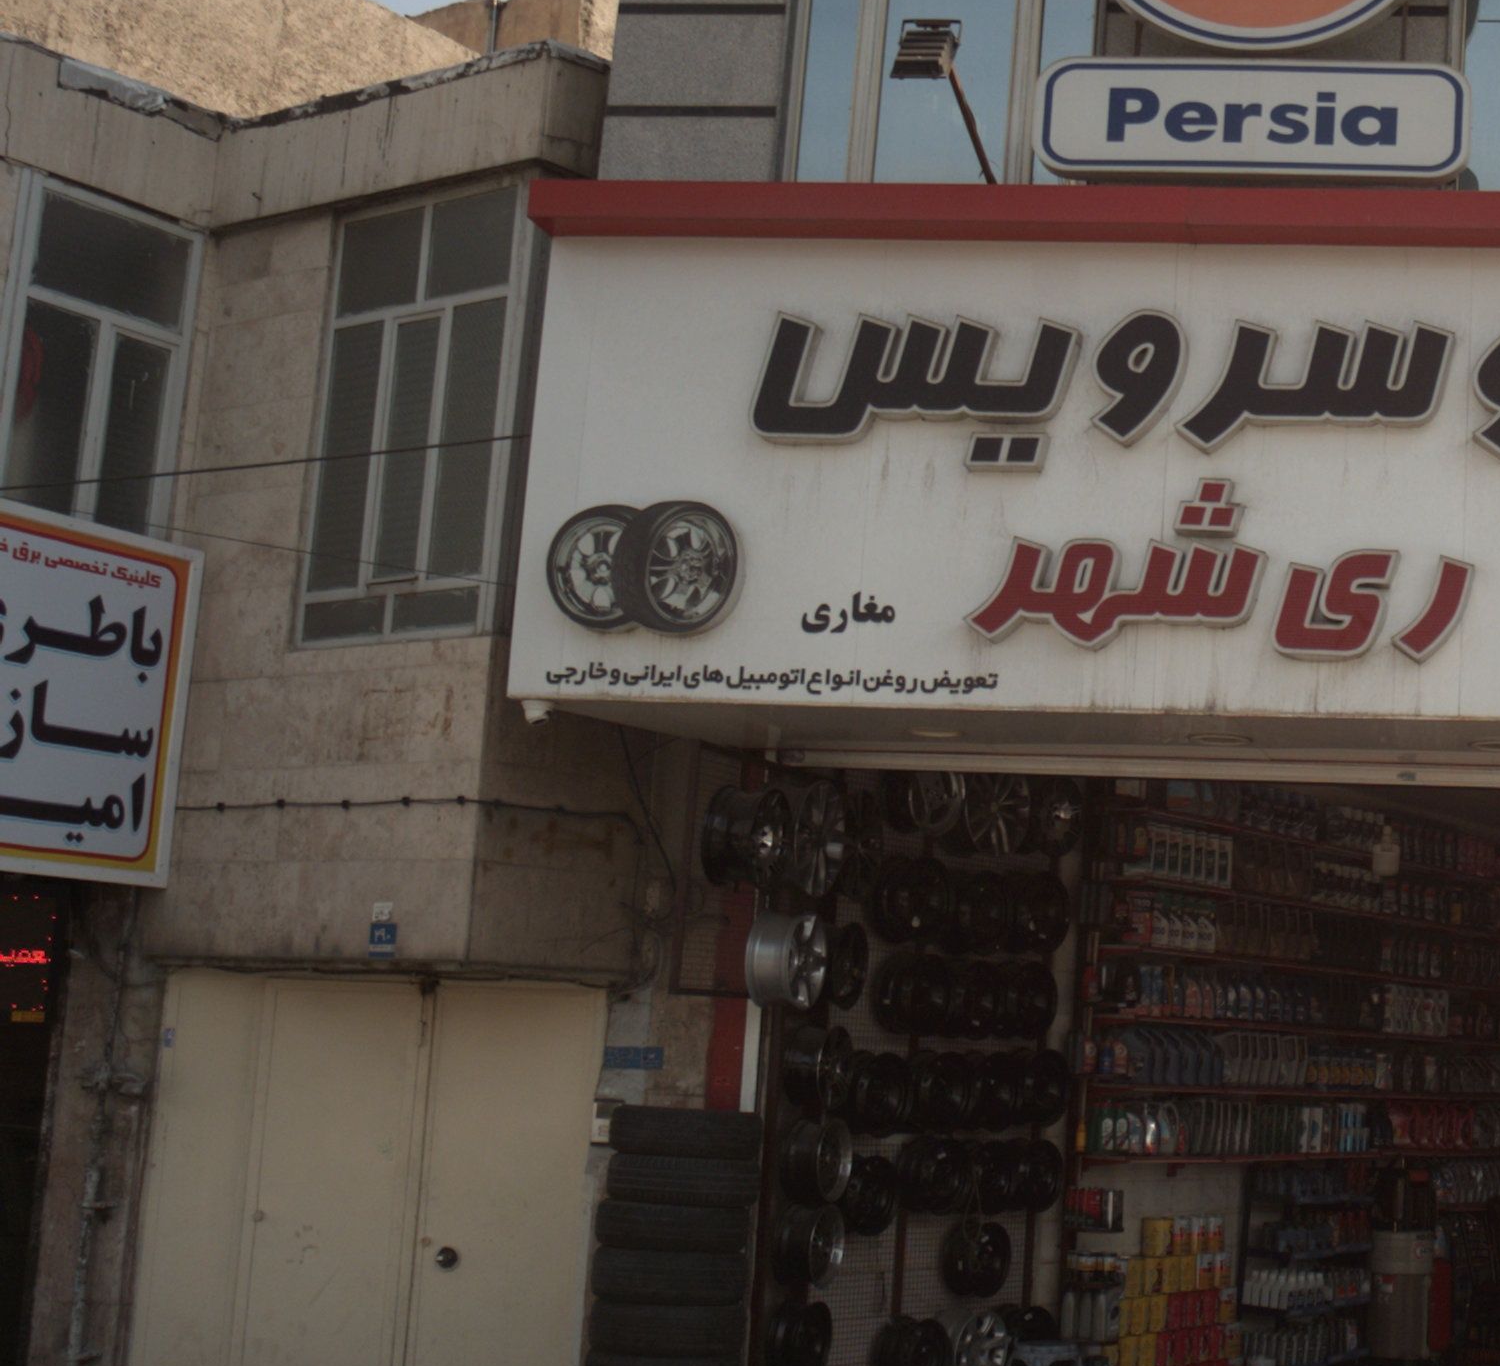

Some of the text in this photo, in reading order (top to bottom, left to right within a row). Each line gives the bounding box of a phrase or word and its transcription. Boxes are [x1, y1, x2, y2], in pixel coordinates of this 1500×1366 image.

[1106, 86, 1399, 146] Persia
[12, 543, 42, 565] برق
[45, 551, 109, 577] تخصصی
[111, 567, 161, 589] کلینیک
[800, 591, 896, 634] مغاری
[545, 661, 608, 686] خارجی
[624, 663, 682, 687] ایرانی
[683, 663, 724, 690] های
[726, 668, 806, 691] اتومبیل
[806, 669, 861, 695] انواع
[862, 672, 919, 694] روغن
[919, 671, 999, 695] تعویض
[0, 772, 147, 845] امی
